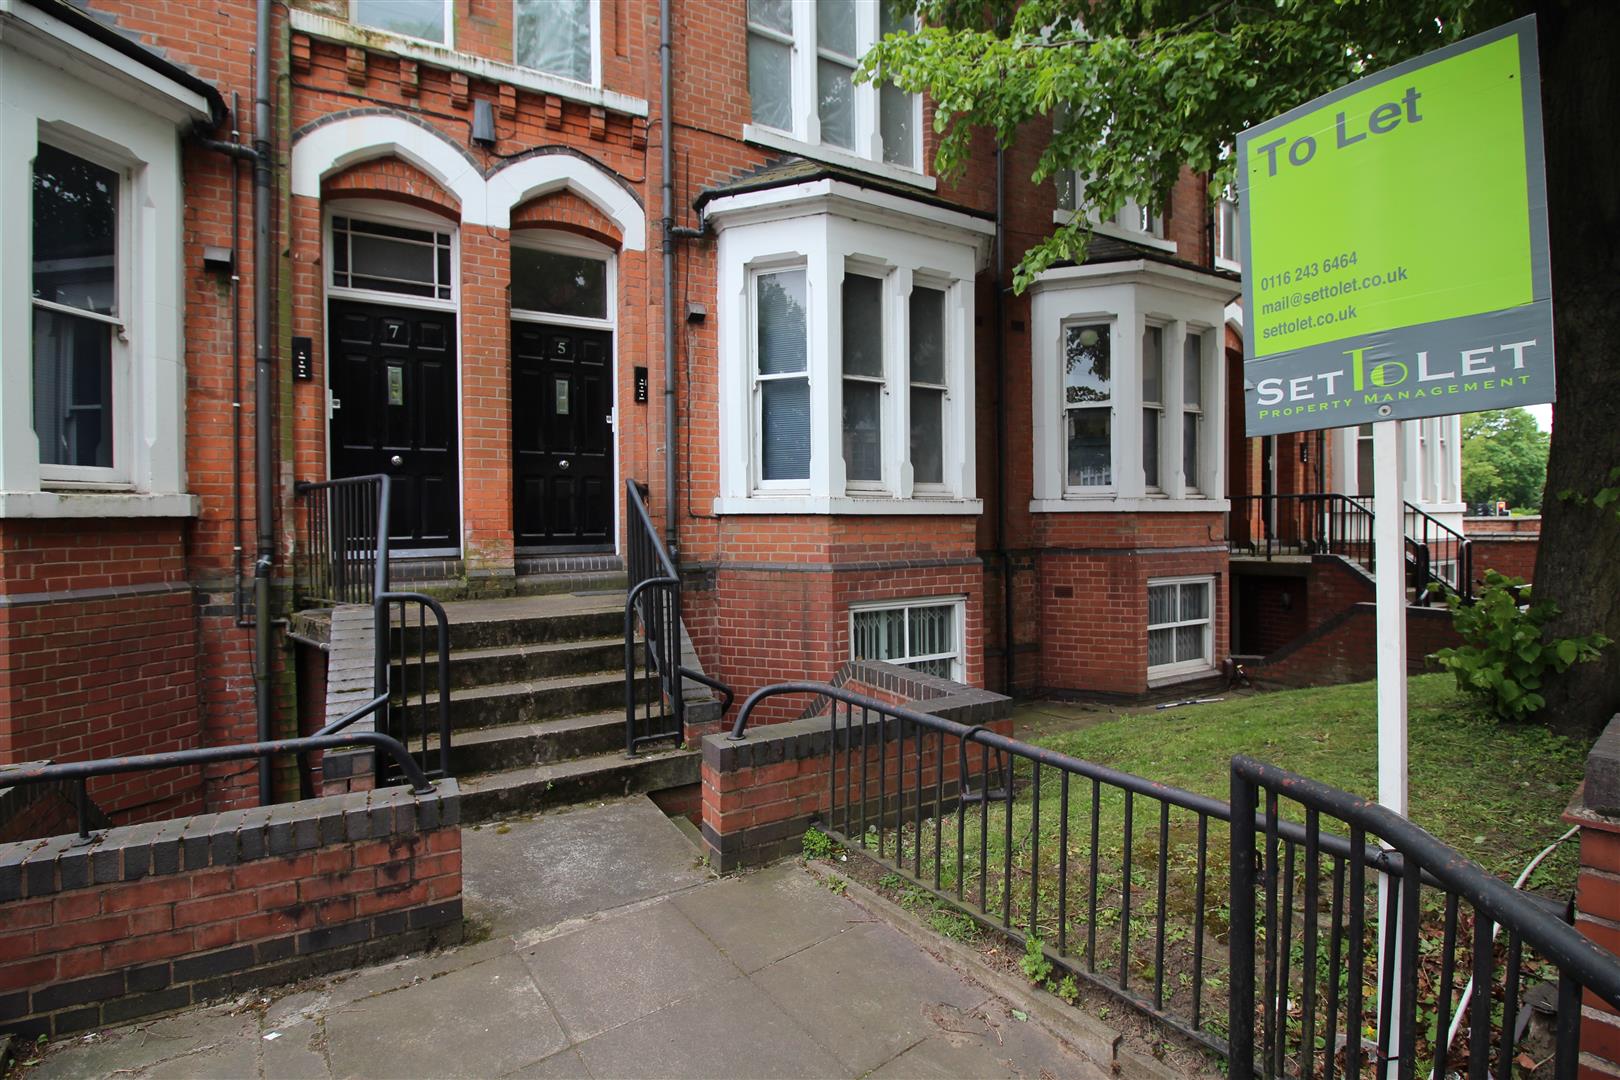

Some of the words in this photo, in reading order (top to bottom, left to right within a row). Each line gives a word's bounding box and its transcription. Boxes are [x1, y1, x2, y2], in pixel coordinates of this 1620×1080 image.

[1257, 136, 1317, 177] To
[1336, 86, 1423, 149] Let
[1261, 271, 1291, 291] 0116
[1295, 262, 1319, 282] 243
[1323, 251, 1358, 273] 6464
[1262, 266, 1408, 315] mail@settolet.co.uk
[388, 324, 399, 339] 7
[1263, 305, 1358, 339] settolet.co.uk
[557, 342, 566, 354] 5
[1259, 398, 1353, 420] PROPERTY
[1364, 374, 1531, 405] MANAGEMENT
